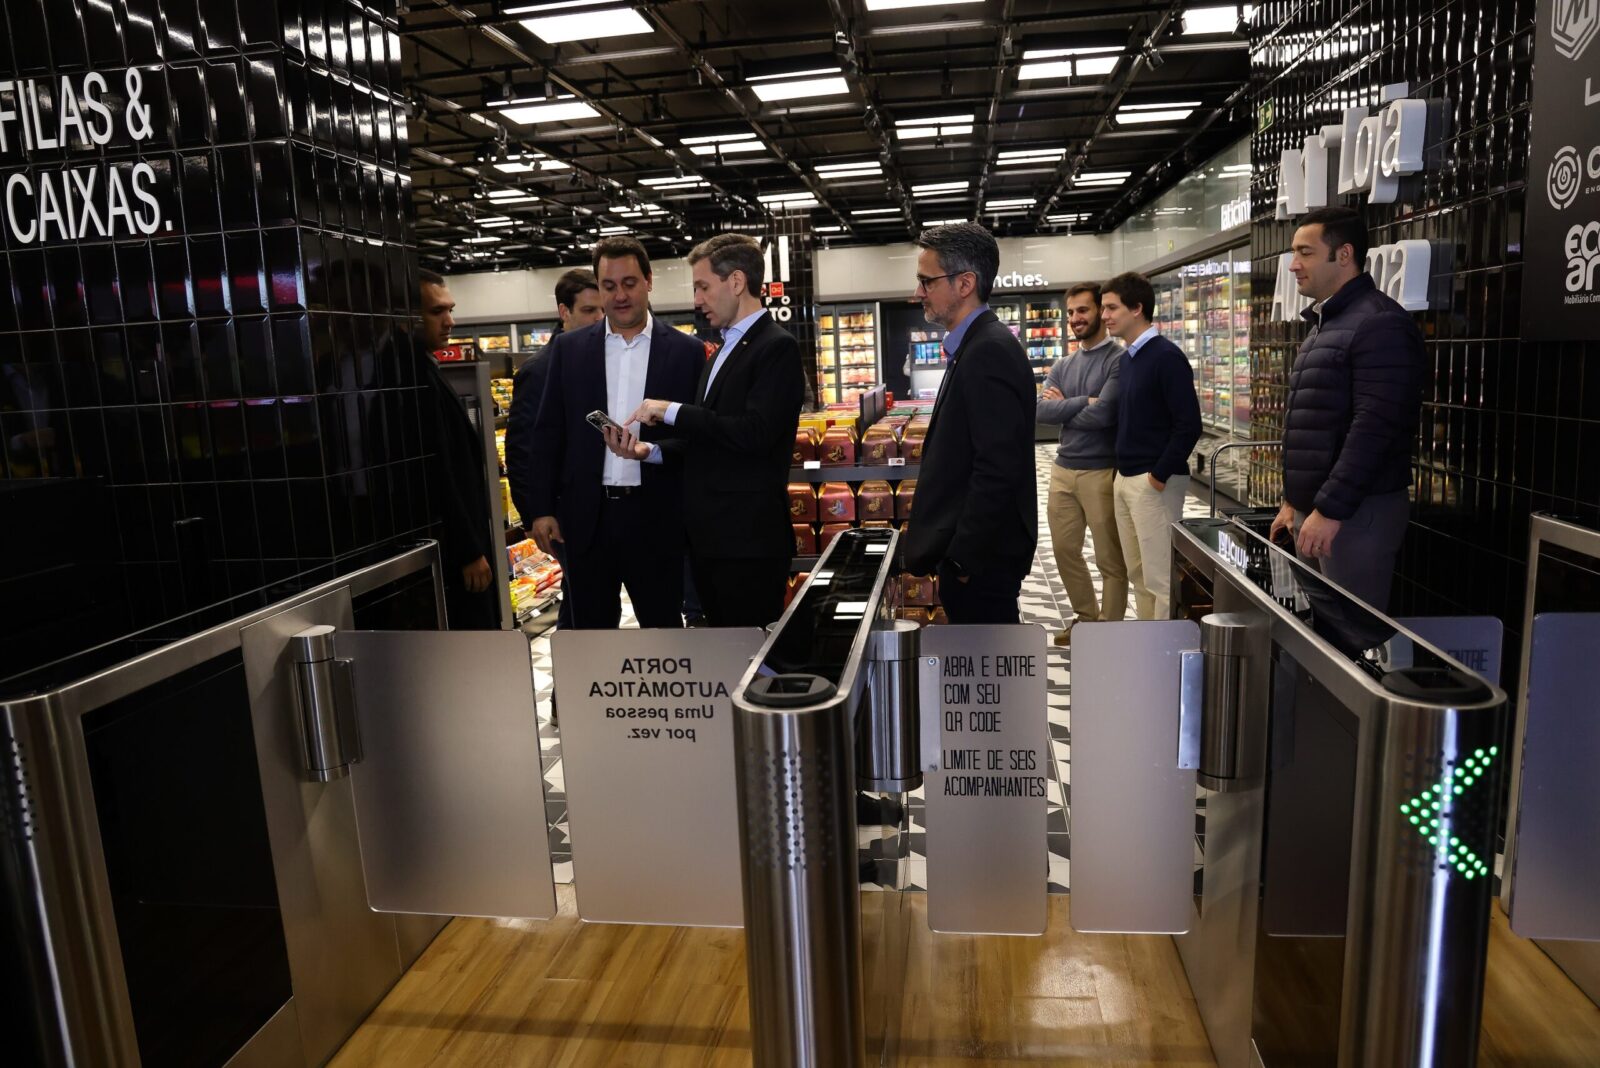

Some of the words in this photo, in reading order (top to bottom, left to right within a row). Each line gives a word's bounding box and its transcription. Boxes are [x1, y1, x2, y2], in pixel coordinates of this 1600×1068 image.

[0, 71, 113, 152] FILAS
[125, 67, 154, 141] &
[1338, 82, 1428, 204] Loja
[6, 162, 174, 244] CAIXAS.
[944, 656, 974, 676] ABRA
[982, 656, 989, 676] E
[996, 656, 1035, 676] ENTRE
[944, 684, 970, 704] COM
[977, 684, 1000, 704] SEU
[946, 712, 962, 732] QR
[970, 712, 1001, 732] CODE
[943, 750, 980, 770] LIMITE
[988, 750, 1003, 770] DE
[1010, 750, 1036, 770] SEIS
